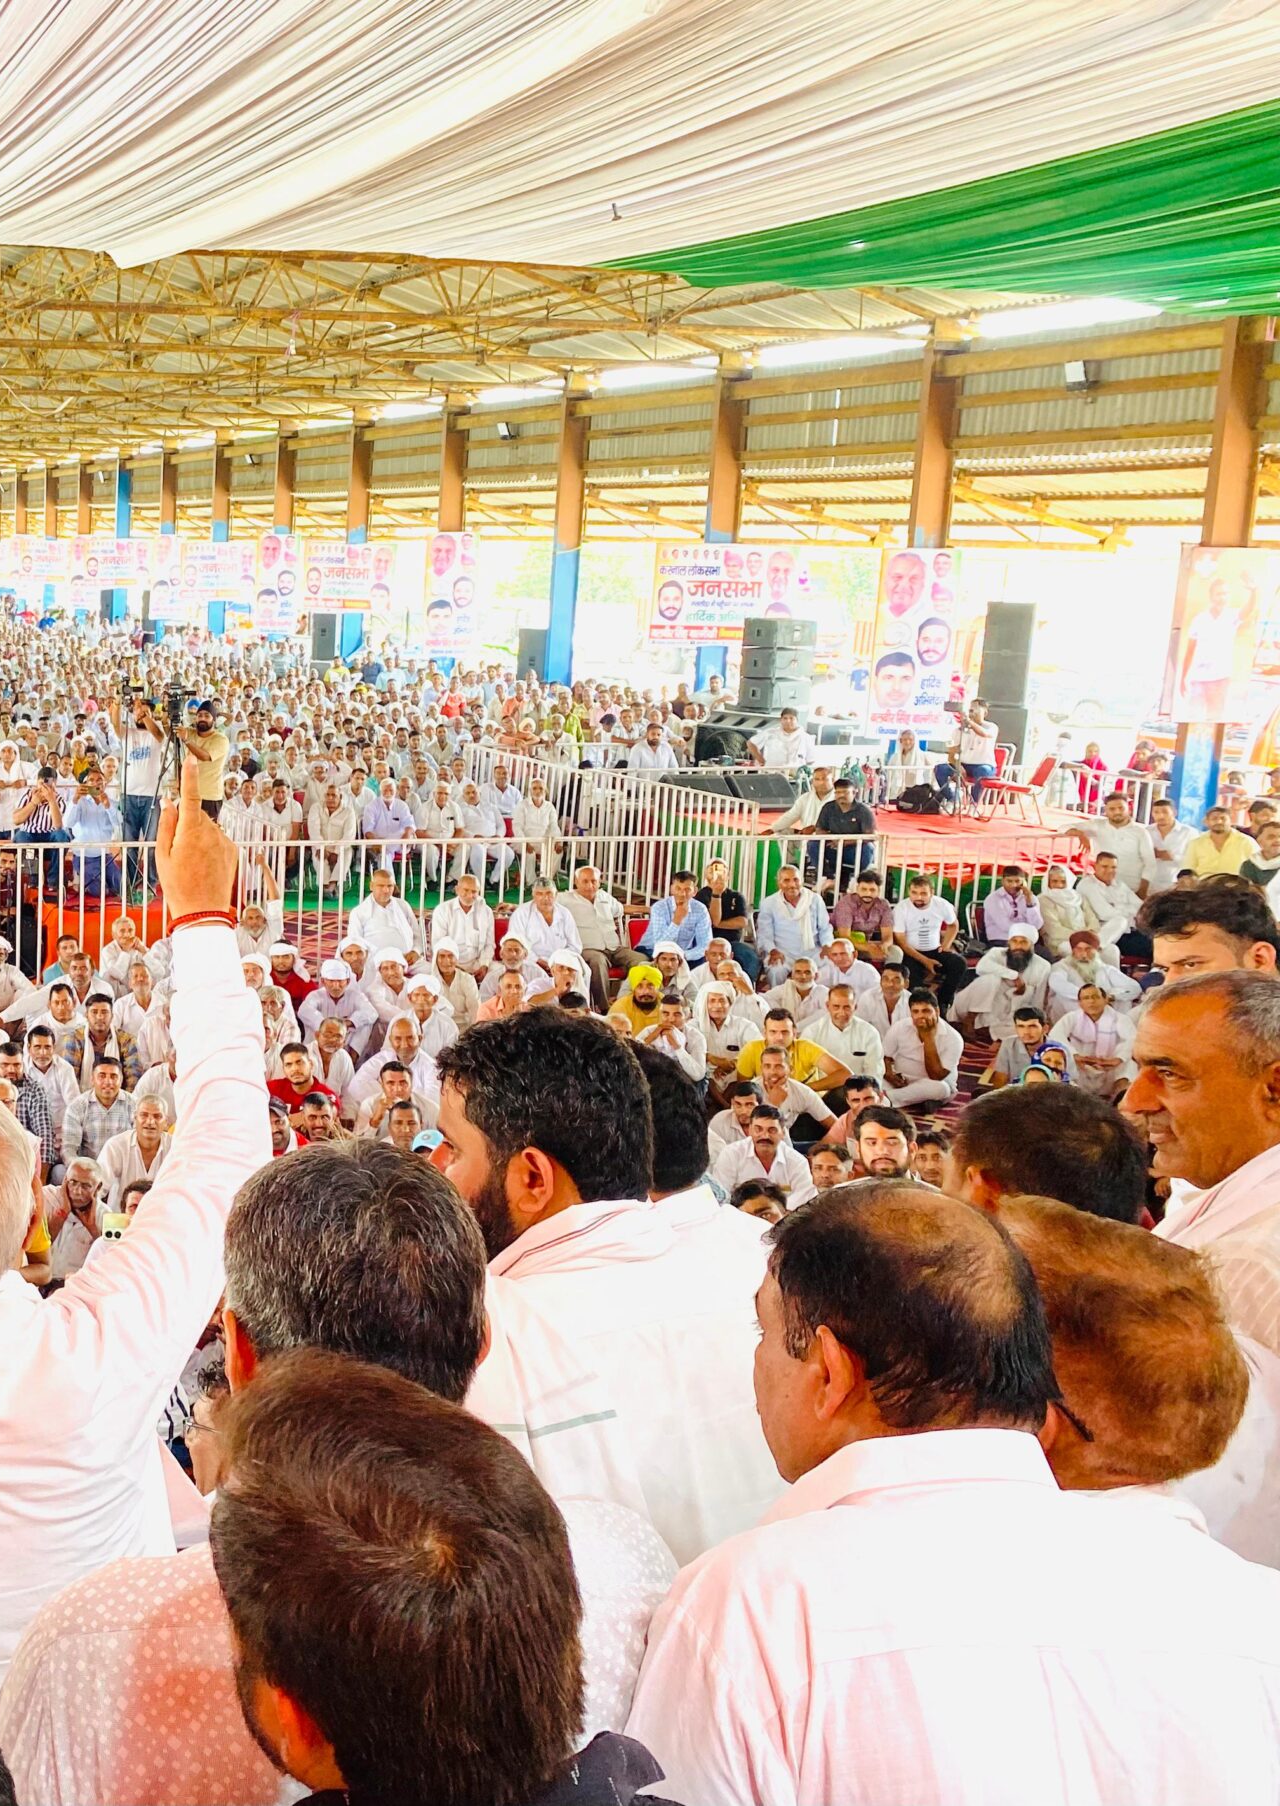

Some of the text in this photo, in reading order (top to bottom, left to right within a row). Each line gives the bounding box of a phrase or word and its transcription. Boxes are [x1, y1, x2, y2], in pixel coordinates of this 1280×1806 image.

[323, 566, 370, 580] जनसभा
[688, 562, 721, 577] लोकसभा
[686, 580, 763, 599] जनसभा
